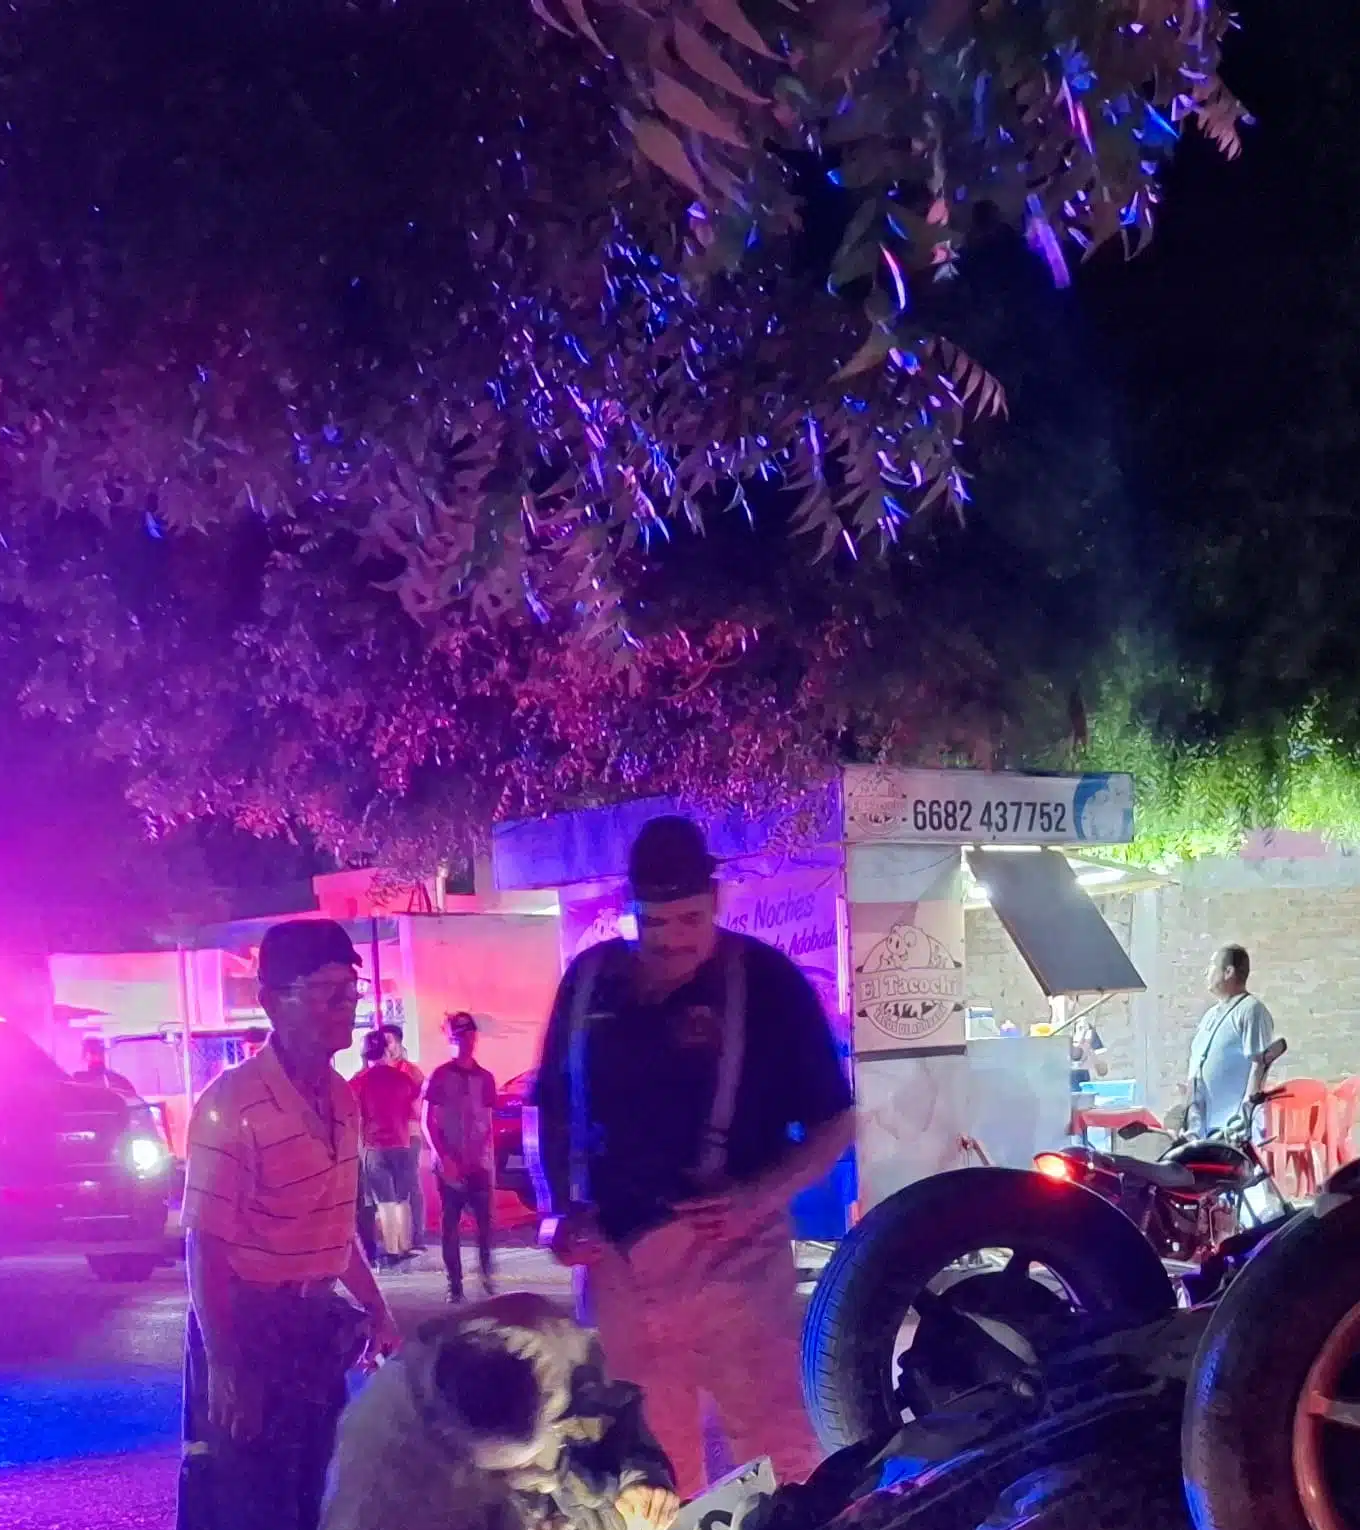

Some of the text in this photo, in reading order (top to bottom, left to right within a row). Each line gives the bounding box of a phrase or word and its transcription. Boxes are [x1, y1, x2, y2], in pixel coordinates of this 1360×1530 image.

[913, 799, 972, 831] 6682
[980, 801, 1067, 833] 437752
[753, 889, 816, 931] Noches
[860, 974, 958, 1001] El Tacochi
